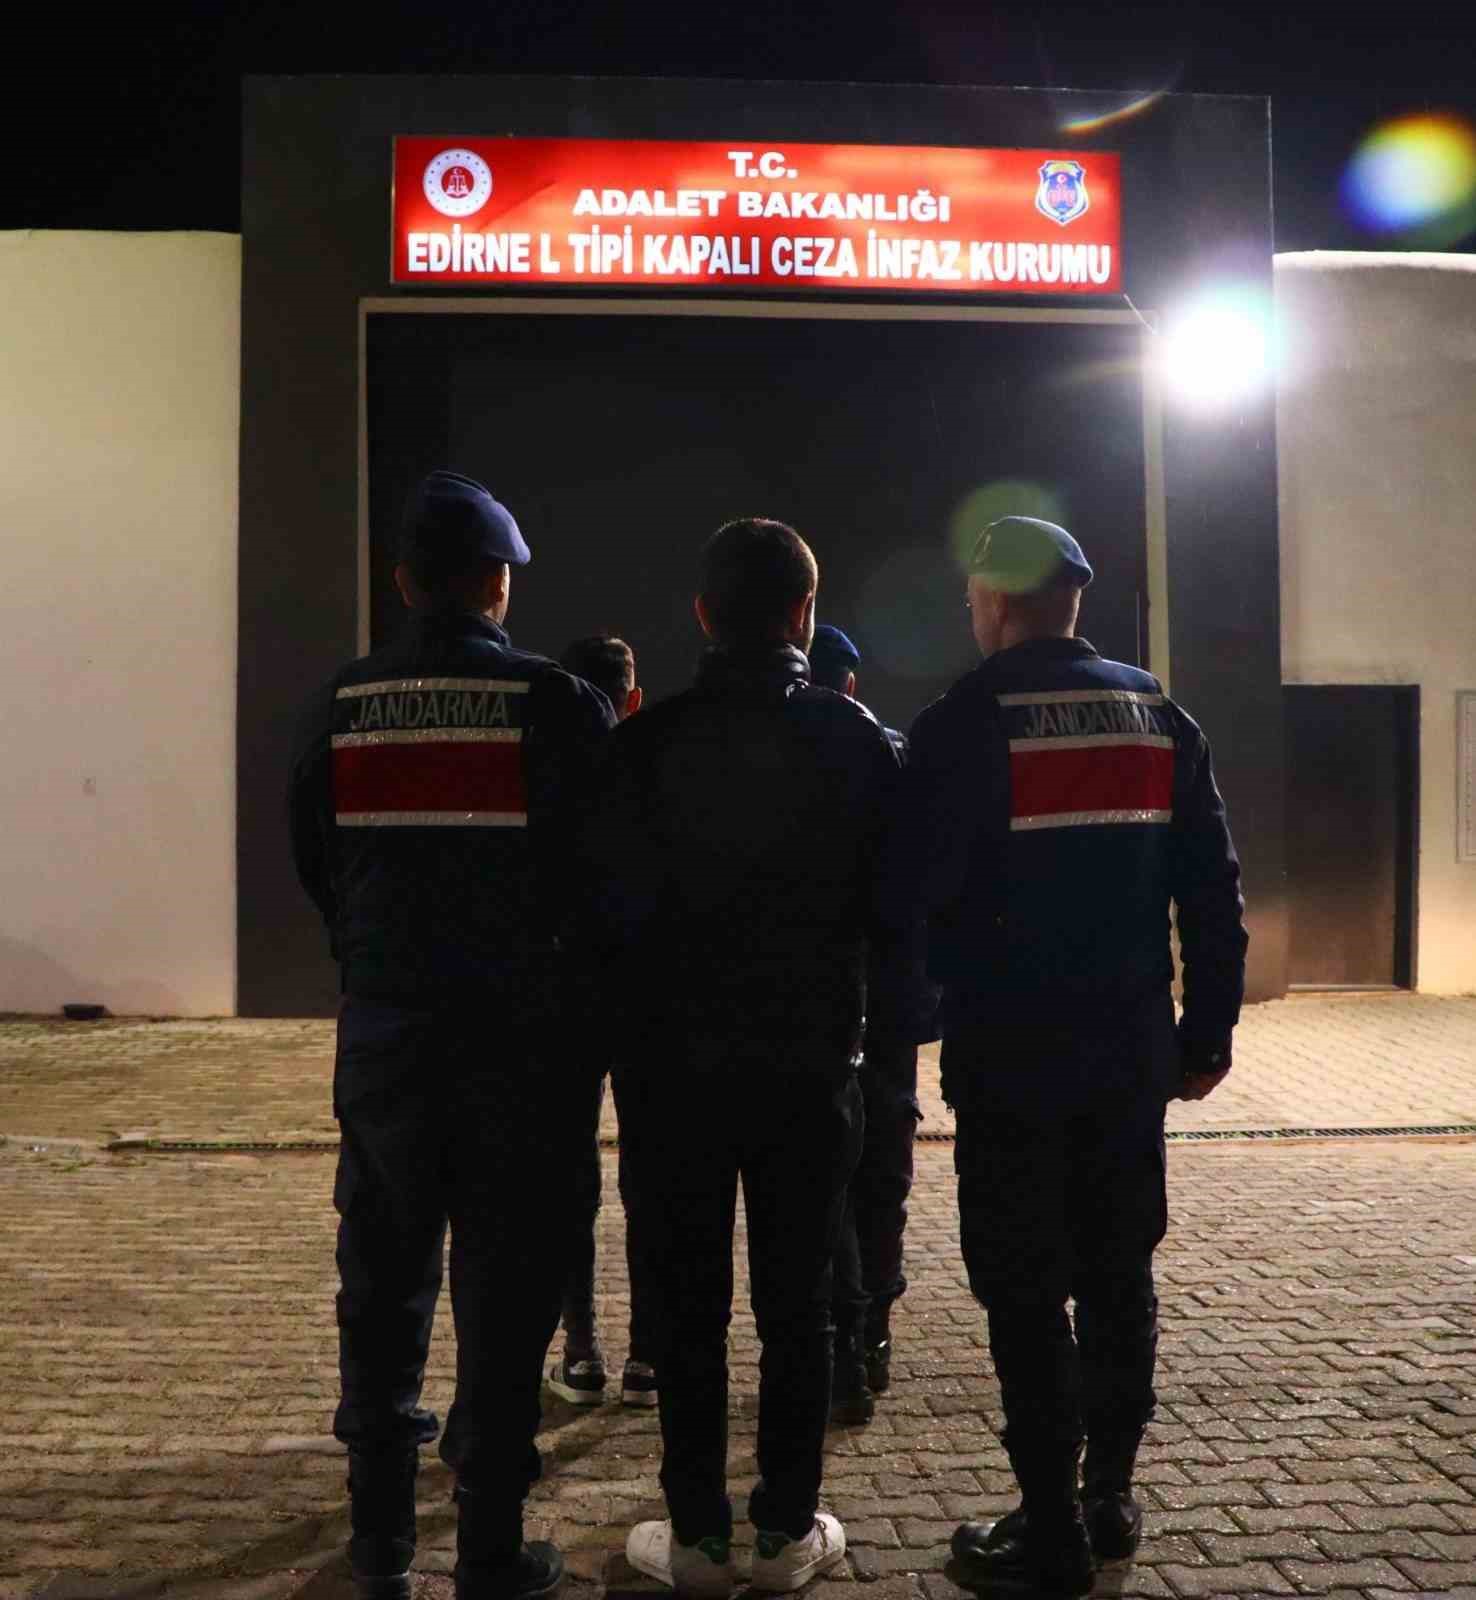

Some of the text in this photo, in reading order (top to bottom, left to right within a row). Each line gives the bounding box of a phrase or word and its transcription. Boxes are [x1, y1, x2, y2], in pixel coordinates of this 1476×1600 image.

[728, 151, 798, 179] T.C.
[572, 189, 950, 222] ADALET BAKANLIĞI
[407, 224, 1112, 284] EDİRNE L TİPİ KAPALI CEZA İNFAZ KURUMU
[351, 690, 510, 731] JANDARMA
